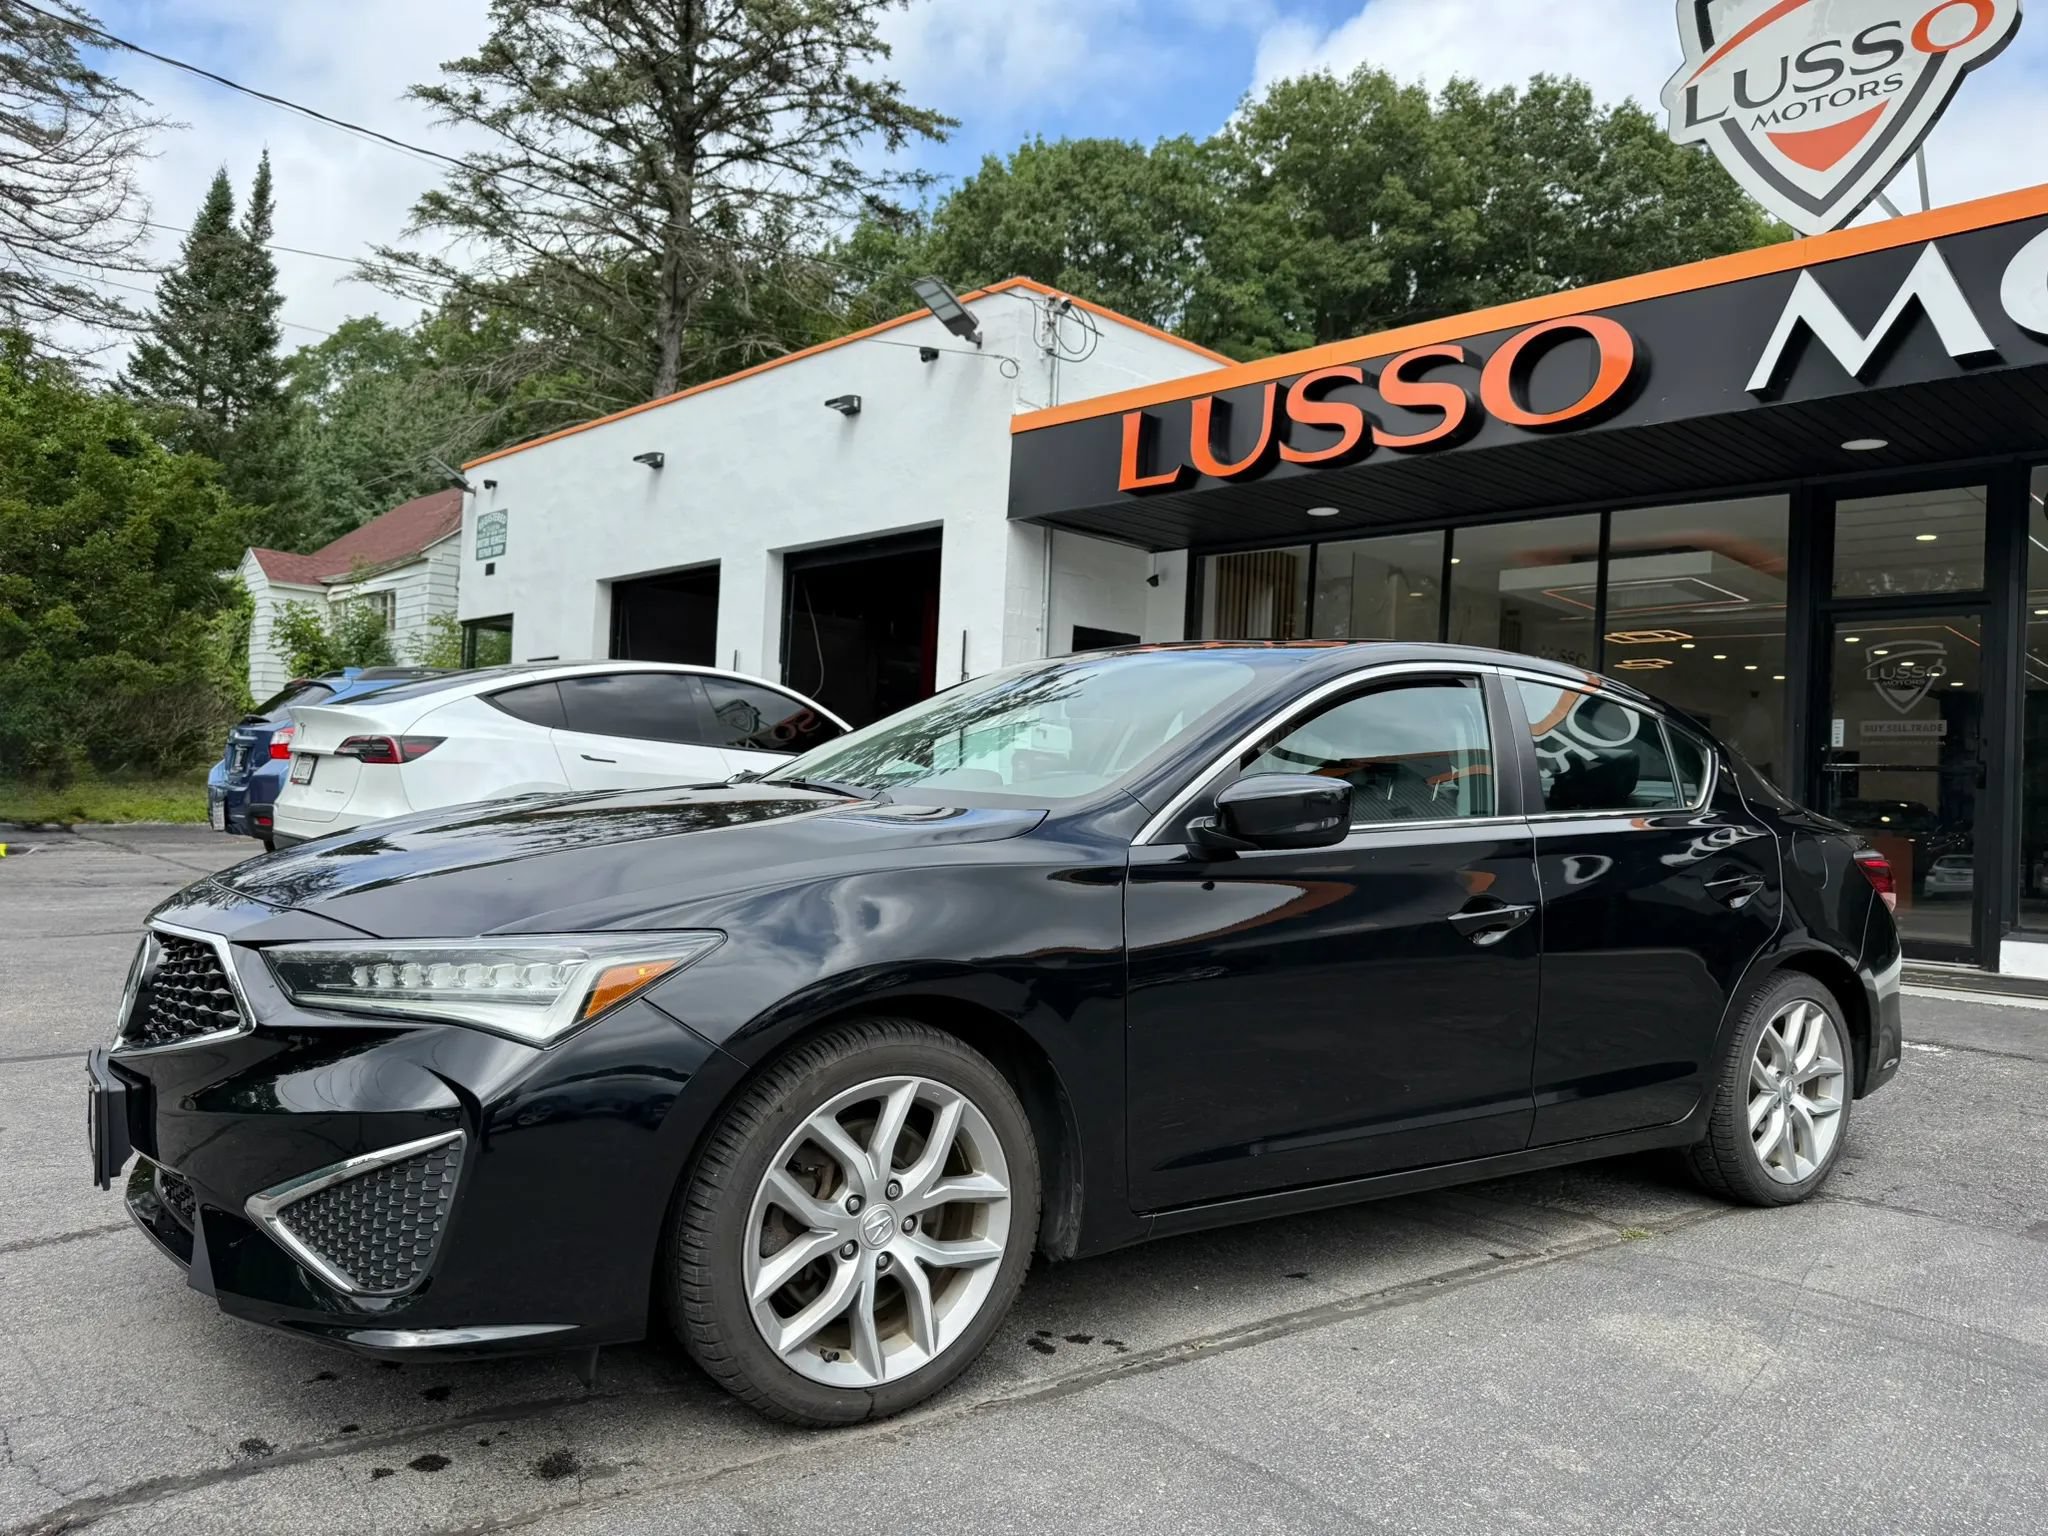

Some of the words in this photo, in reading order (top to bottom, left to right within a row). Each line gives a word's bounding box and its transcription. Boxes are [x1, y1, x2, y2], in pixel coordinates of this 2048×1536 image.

[1685, 0, 1995, 128] LUSSO
[1750, 72, 1903, 132] MOTORS
[1117, 314, 1634, 492] LUSSO
[1867, 664, 1948, 680] LUSSO
